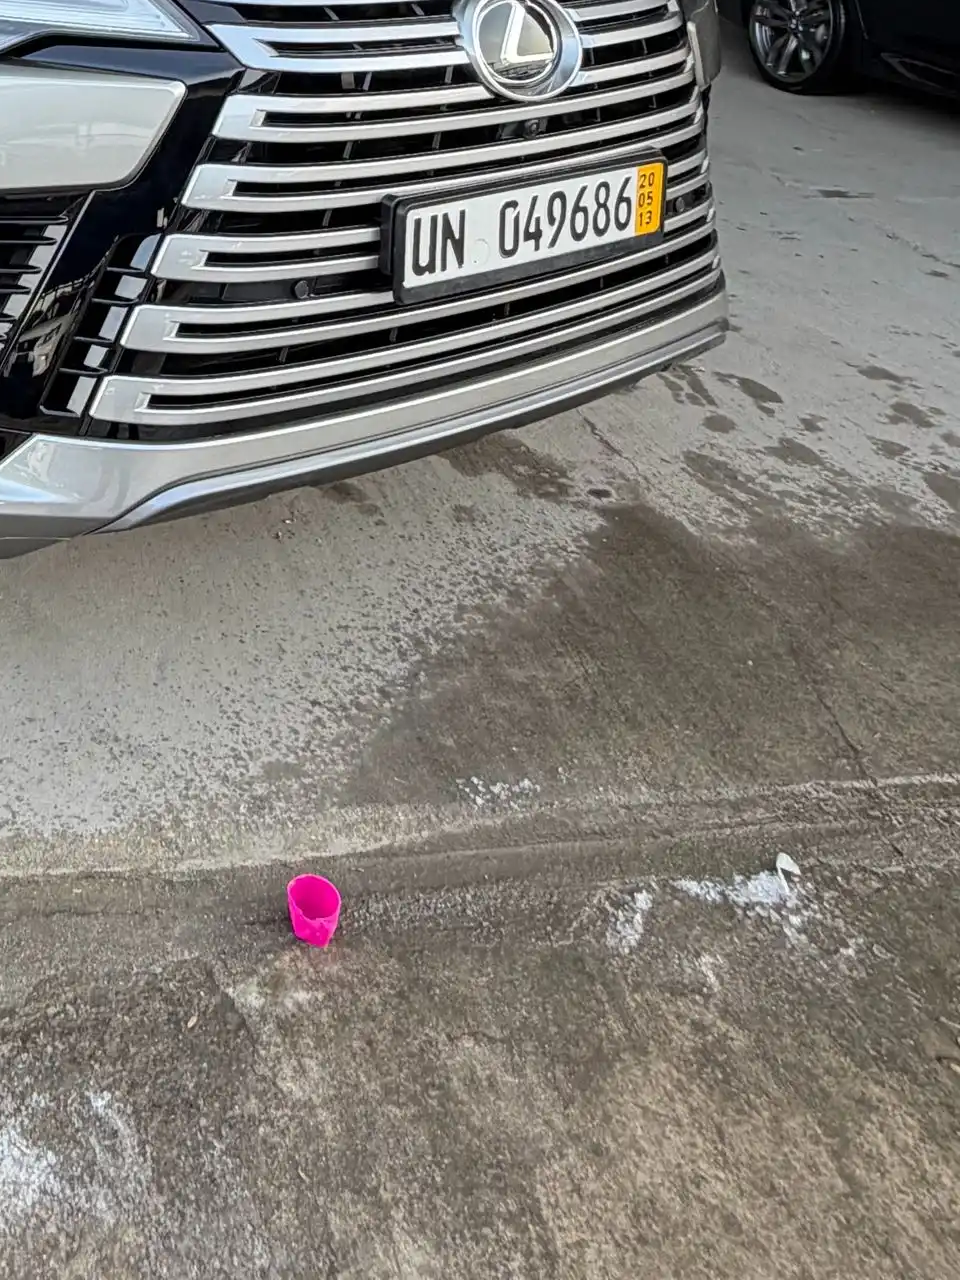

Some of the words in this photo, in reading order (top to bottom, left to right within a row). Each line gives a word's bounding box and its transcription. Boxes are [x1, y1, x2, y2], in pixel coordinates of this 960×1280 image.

[639, 172, 655, 188] 20
[638, 191, 653, 208] 05
[411, 209, 466, 276] UN
[498, 176, 632, 258] 049686
[639, 210, 653, 227] 13
